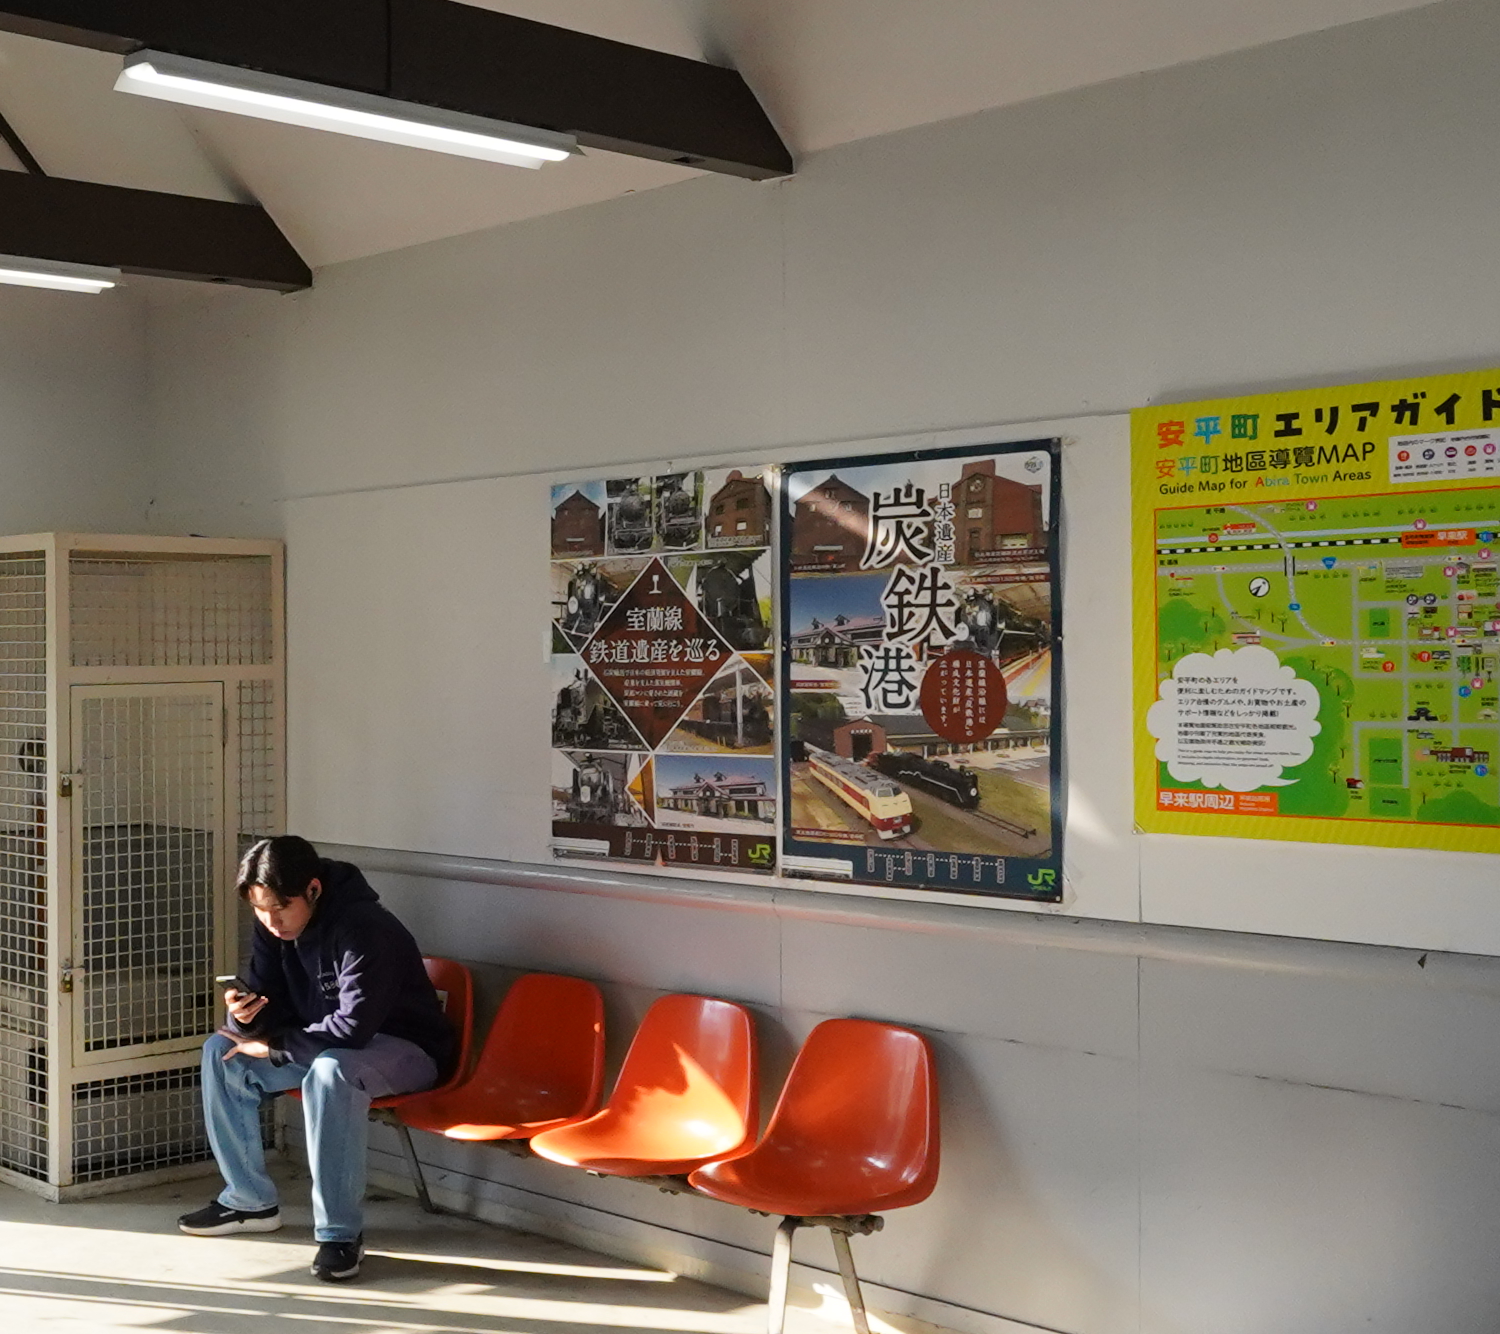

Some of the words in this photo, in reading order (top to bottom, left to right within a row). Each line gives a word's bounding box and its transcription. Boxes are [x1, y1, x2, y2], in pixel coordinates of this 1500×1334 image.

[1159, 479, 1195, 496] Guide
[1198, 478, 1226, 496] Map
[1229, 477, 1248, 491] for
[1255, 475, 1290, 489] Abira
[1294, 472, 1330, 486] Town
[1332, 468, 1373, 483] Areas
[935, 482, 955, 564] 日本遺産
[859, 487, 958, 711] 炭鉄港
[625, 606, 683, 632] 室蘭線
[588, 637, 721, 664] 鉄道遺産を巡る
[1159, 791, 1235, 810] 早来駅周辺
[747, 843, 772, 859] JR
[1027, 868, 1057, 885] JR
